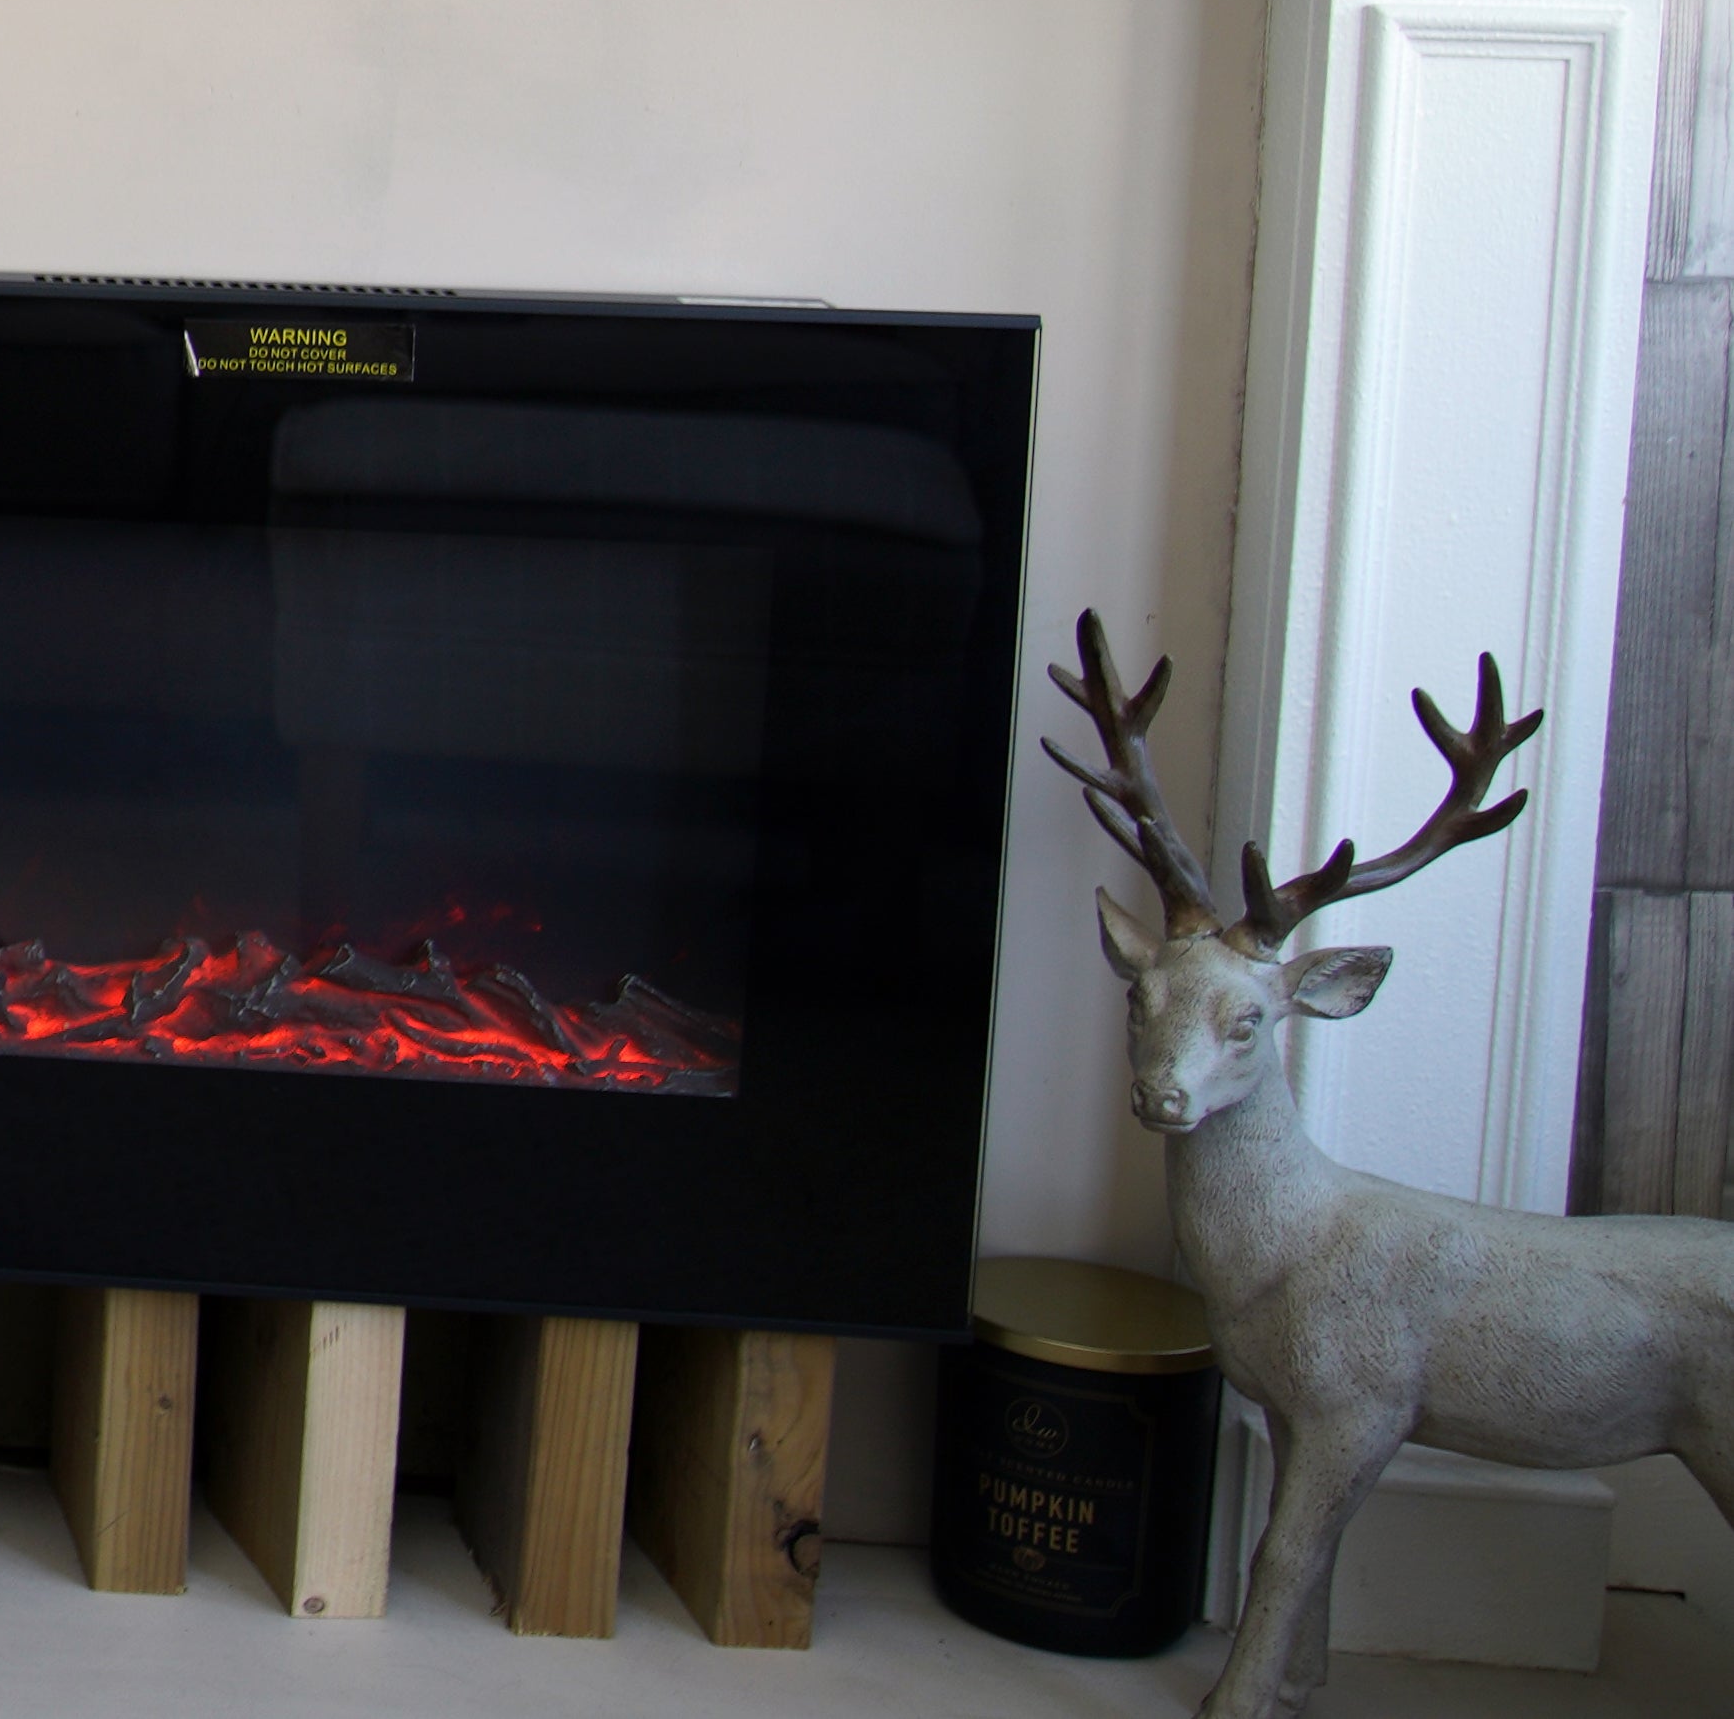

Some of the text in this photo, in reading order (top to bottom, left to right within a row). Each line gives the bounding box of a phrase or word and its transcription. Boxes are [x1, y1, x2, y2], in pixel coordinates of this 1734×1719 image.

[249, 327, 347, 347] WARNING
[249, 346, 347, 361] DO NOT COVER
[197, 356, 398, 376] DO NOT TOUCH HOT SURFACES
[978, 1472, 1096, 1526] PUMPKIN
[987, 1506, 1081, 1554] TOFFEE
